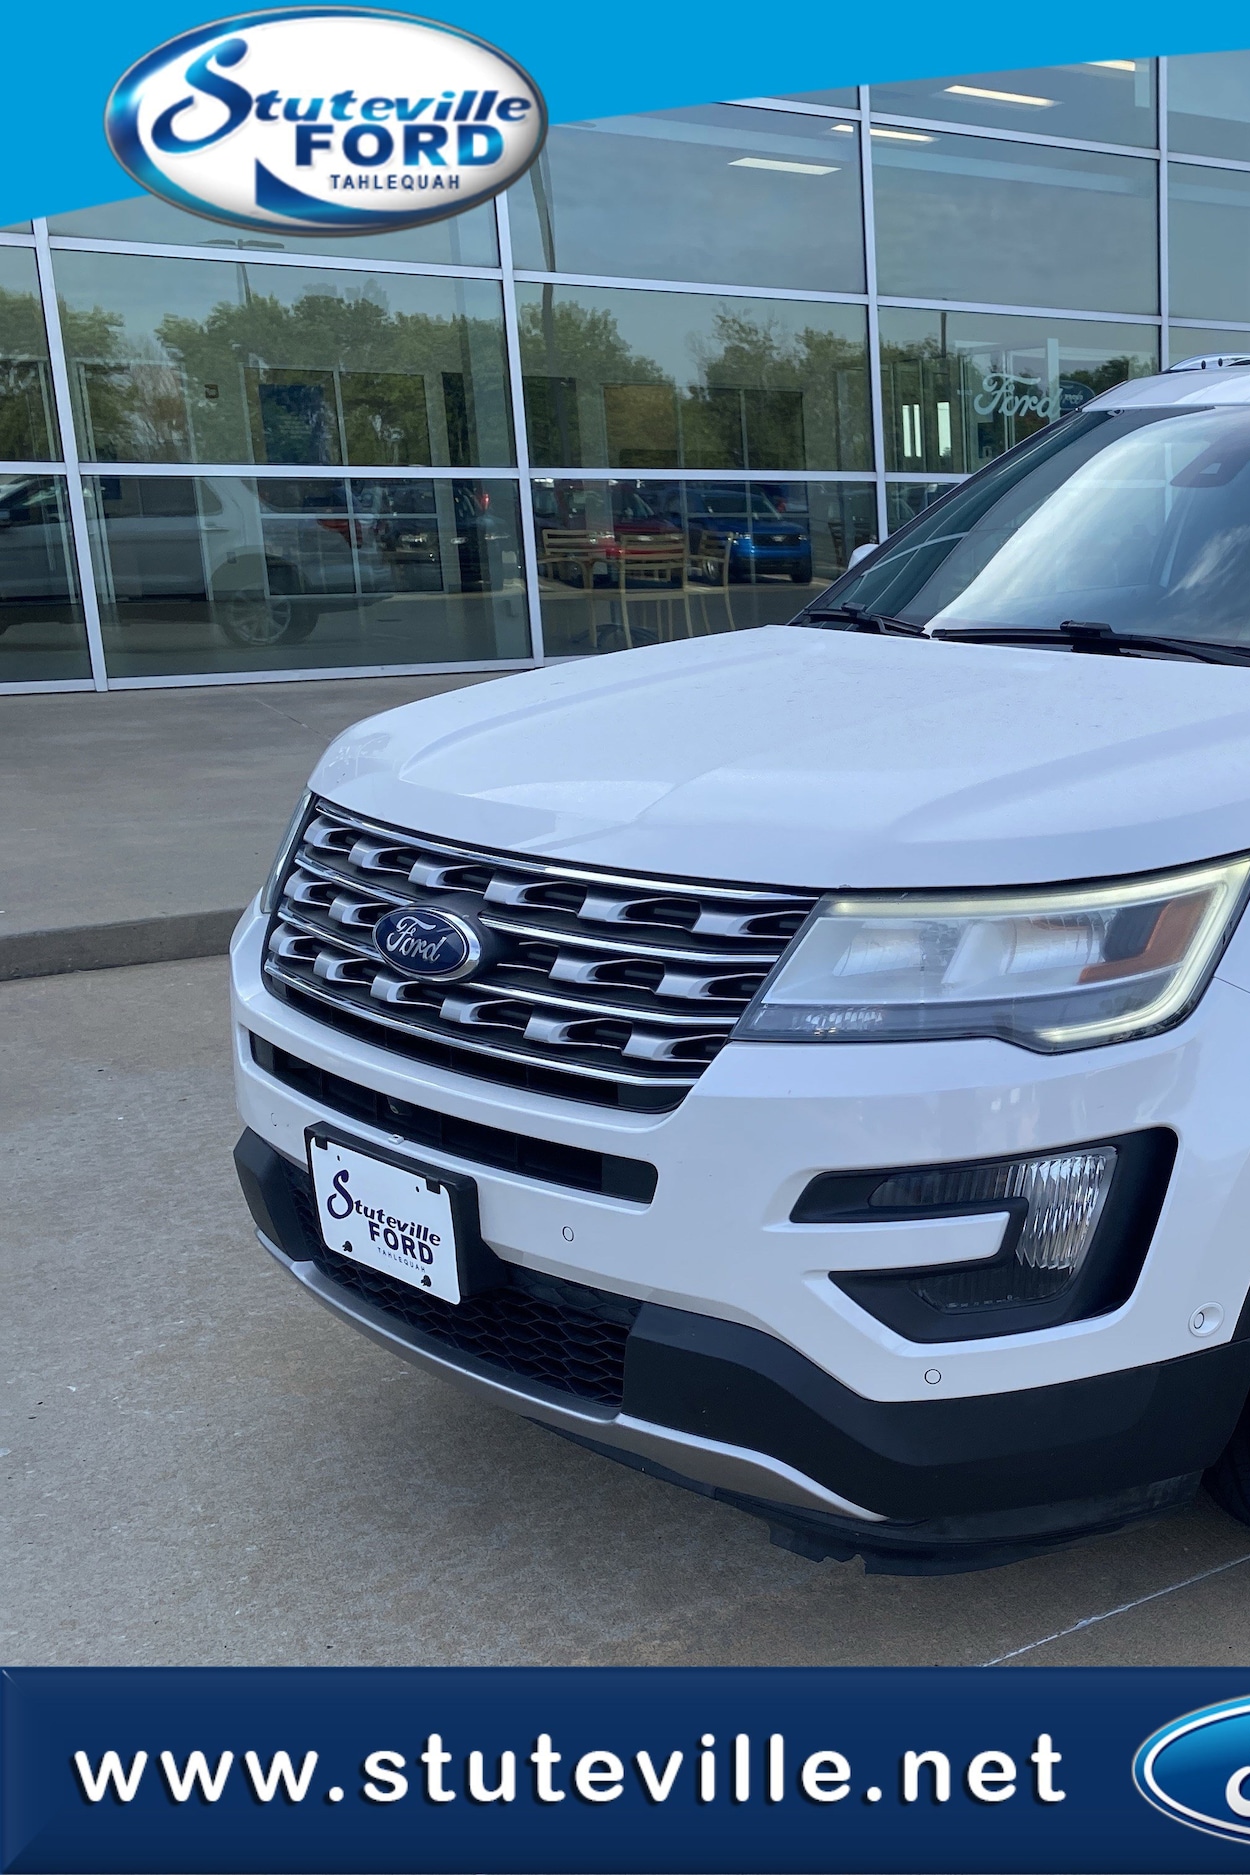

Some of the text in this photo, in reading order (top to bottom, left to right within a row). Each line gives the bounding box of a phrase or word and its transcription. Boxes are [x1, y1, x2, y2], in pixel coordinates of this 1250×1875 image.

[974, 373, 1062, 418] Ford
[386, 916, 447, 963] Ford
[327, 1169, 442, 1247] Stuteville
[368, 1221, 434, 1265] FORD
[378, 1247, 426, 1273] TAHLEQUAH
